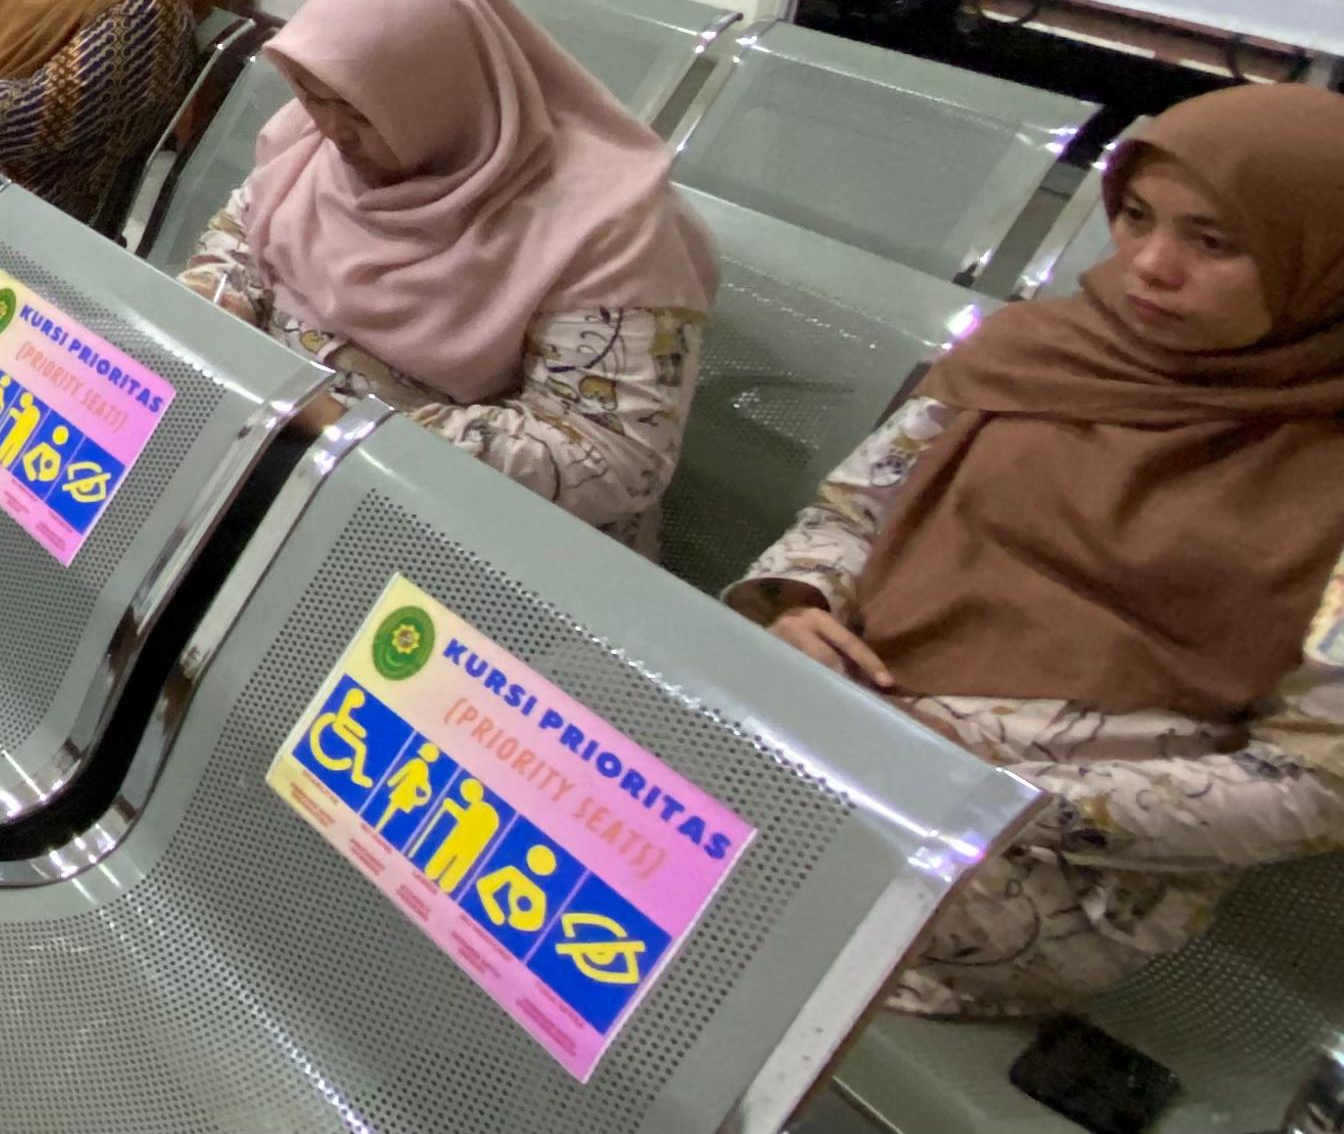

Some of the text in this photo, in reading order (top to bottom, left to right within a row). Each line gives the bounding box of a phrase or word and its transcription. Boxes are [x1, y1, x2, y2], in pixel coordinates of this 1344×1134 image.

[15, 341, 84, 397] (PRIORITY
[19, 305, 165, 413] KURSI PRIORITAS
[443, 638, 732, 860] KURSI PRIORITAS
[443, 697, 666, 878] (PRIORITY SEATS)
